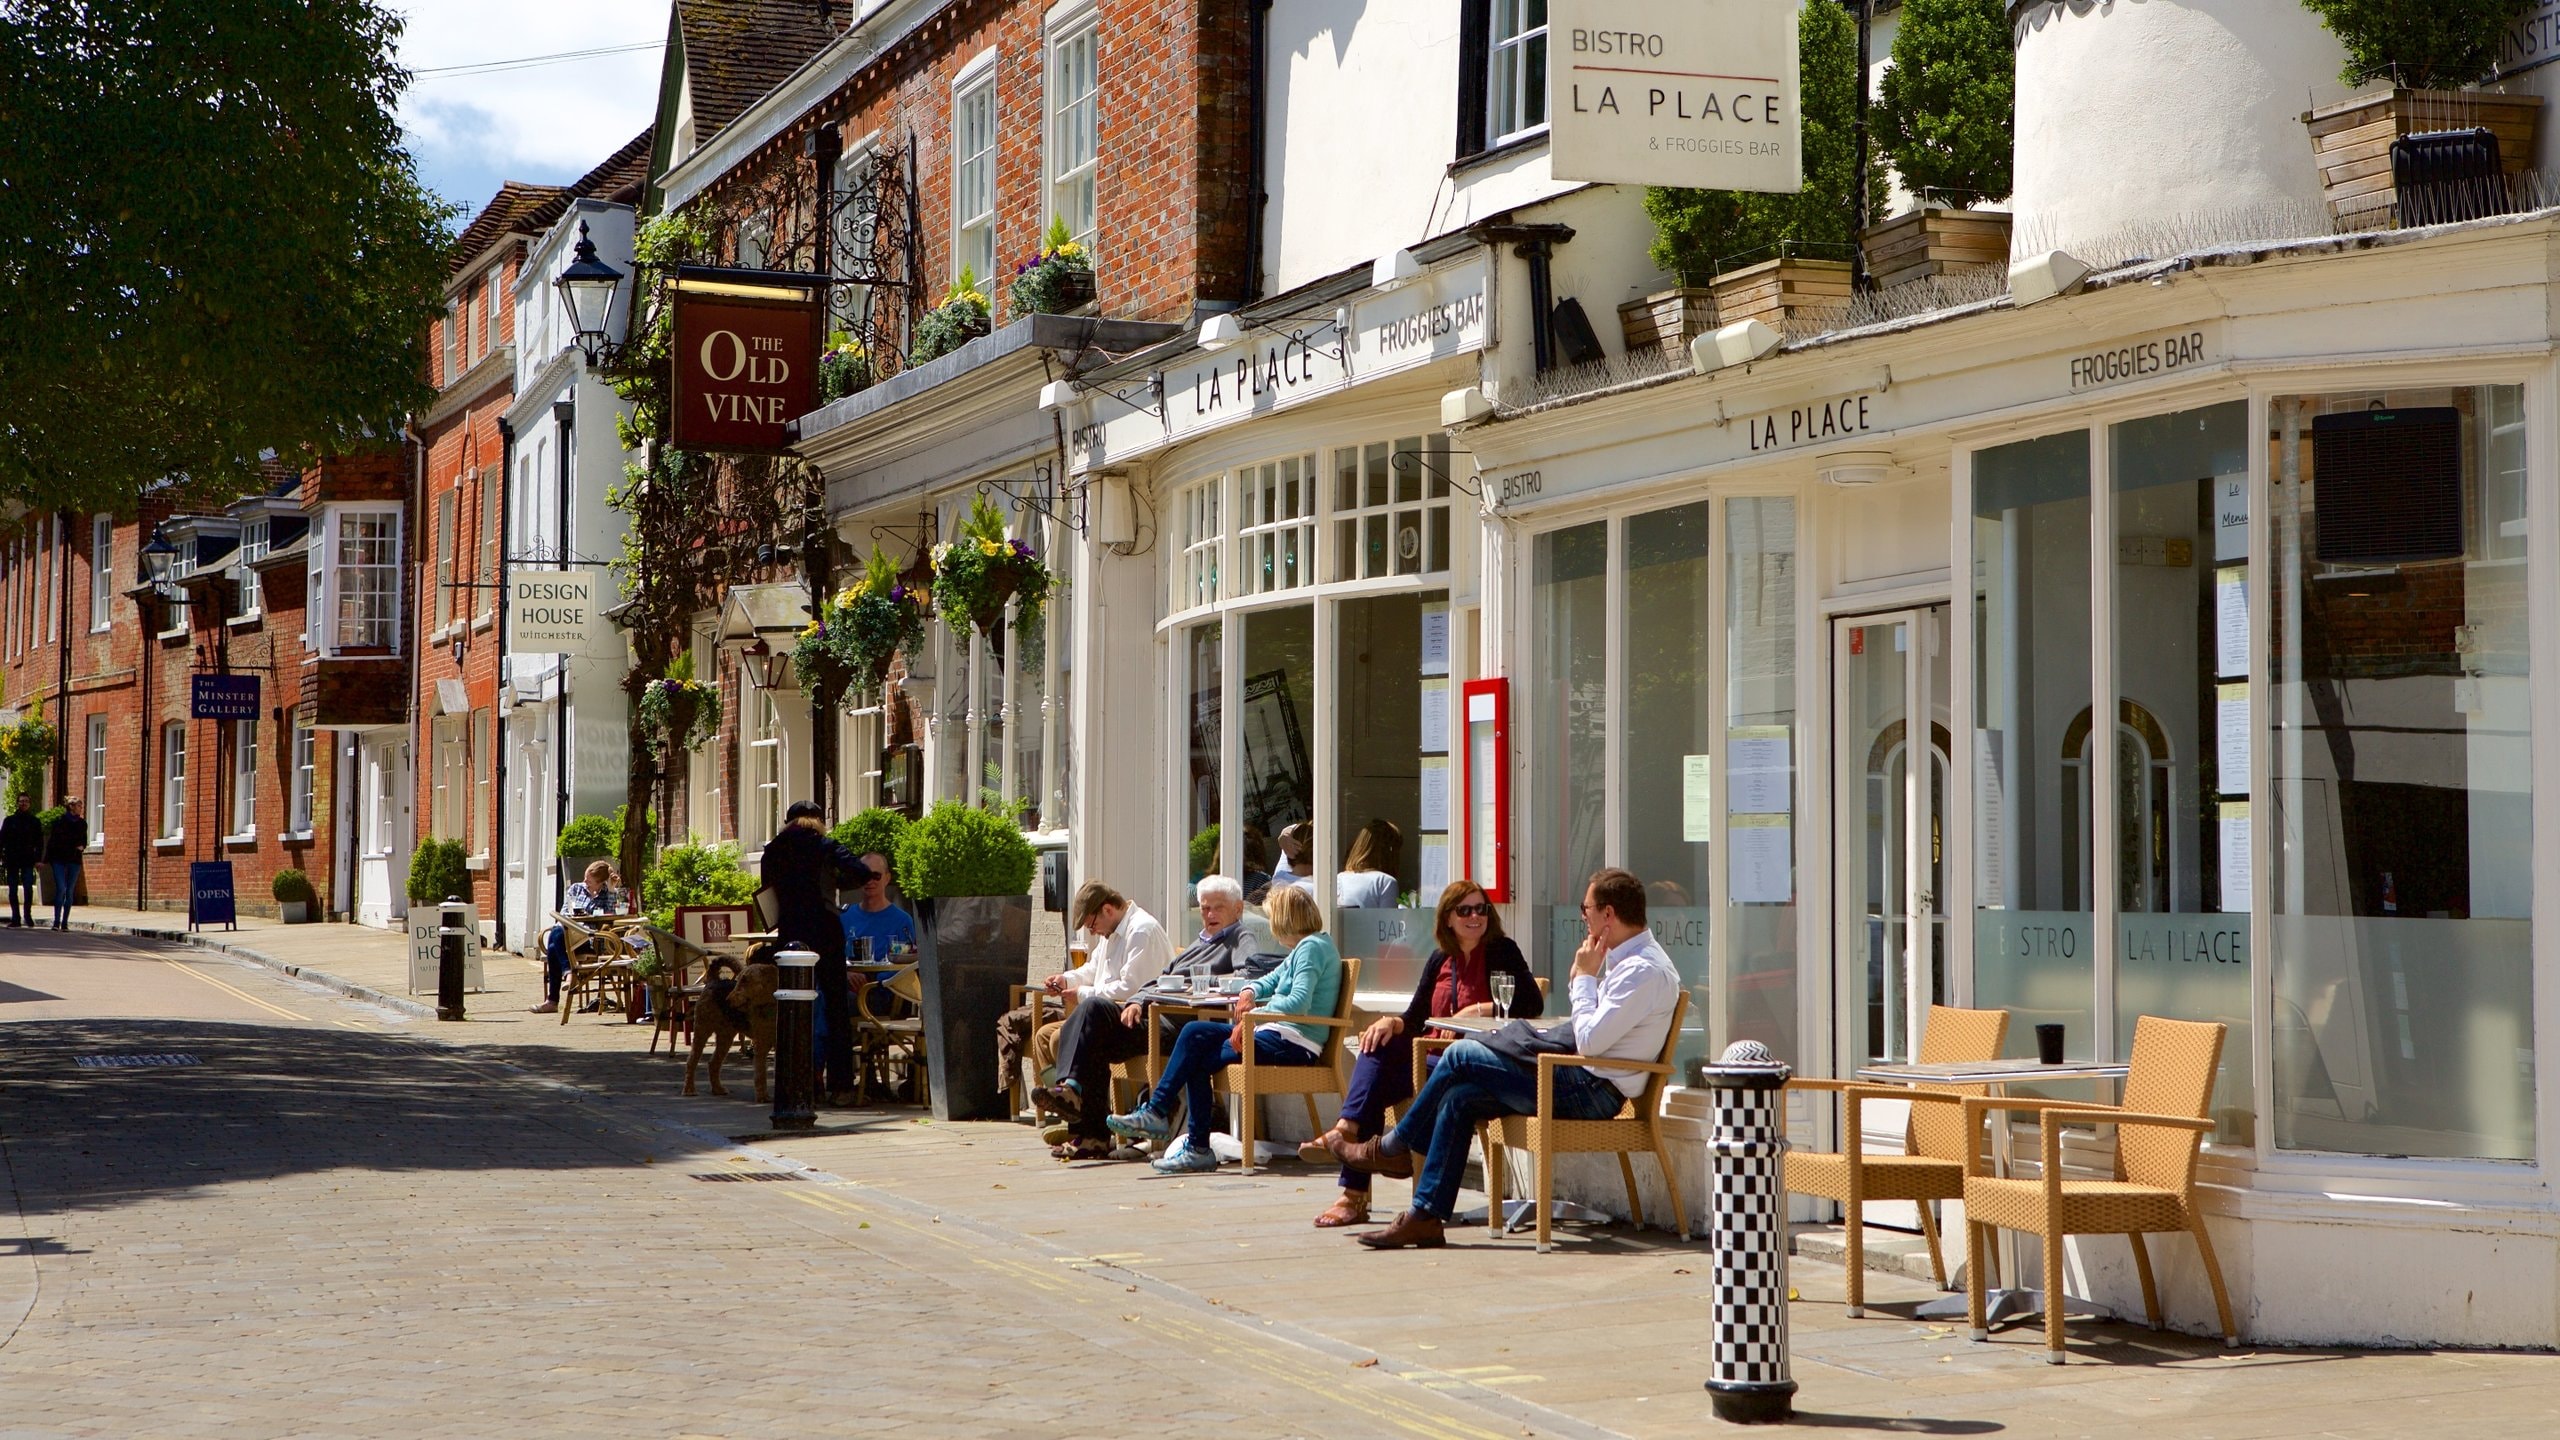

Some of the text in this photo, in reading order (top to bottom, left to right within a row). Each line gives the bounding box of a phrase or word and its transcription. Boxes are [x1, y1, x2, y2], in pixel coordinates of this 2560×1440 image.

[1572, 29, 1664, 58] BISTRO
[1573, 84, 1780, 125] LA PLACE
[1649, 136, 1780, 157] & FROGGIES BAR
[1380, 292, 1484, 356] FROGGIES BAR
[700, 330, 790, 384] OLD
[751, 336, 783, 352] THE
[2071, 332, 2205, 388] FROGGIES BAR
[1196, 335, 1313, 415] LA PLACE
[703, 392, 786, 425] VINE
[1750, 395, 1870, 450] LA PLACE
[1072, 420, 1107, 457] BISTRO
[1502, 470, 1542, 500] BISTRO
[2228, 482, 2240, 496] Le
[2222, 511, 2249, 527] Menu
[519, 583, 588, 600] DESIGN
[522, 608, 584, 624] HOUSE
[198, 691, 254, 701] MINSTER
[198, 704, 254, 714] GALLERY
[197, 889, 230, 899] OPEN
[1377, 919, 1407, 942] BAR
[1655, 919, 1703, 947] PLACE
[2128, 928, 2155, 961] LA
[417, 942, 477, 960] HOE
